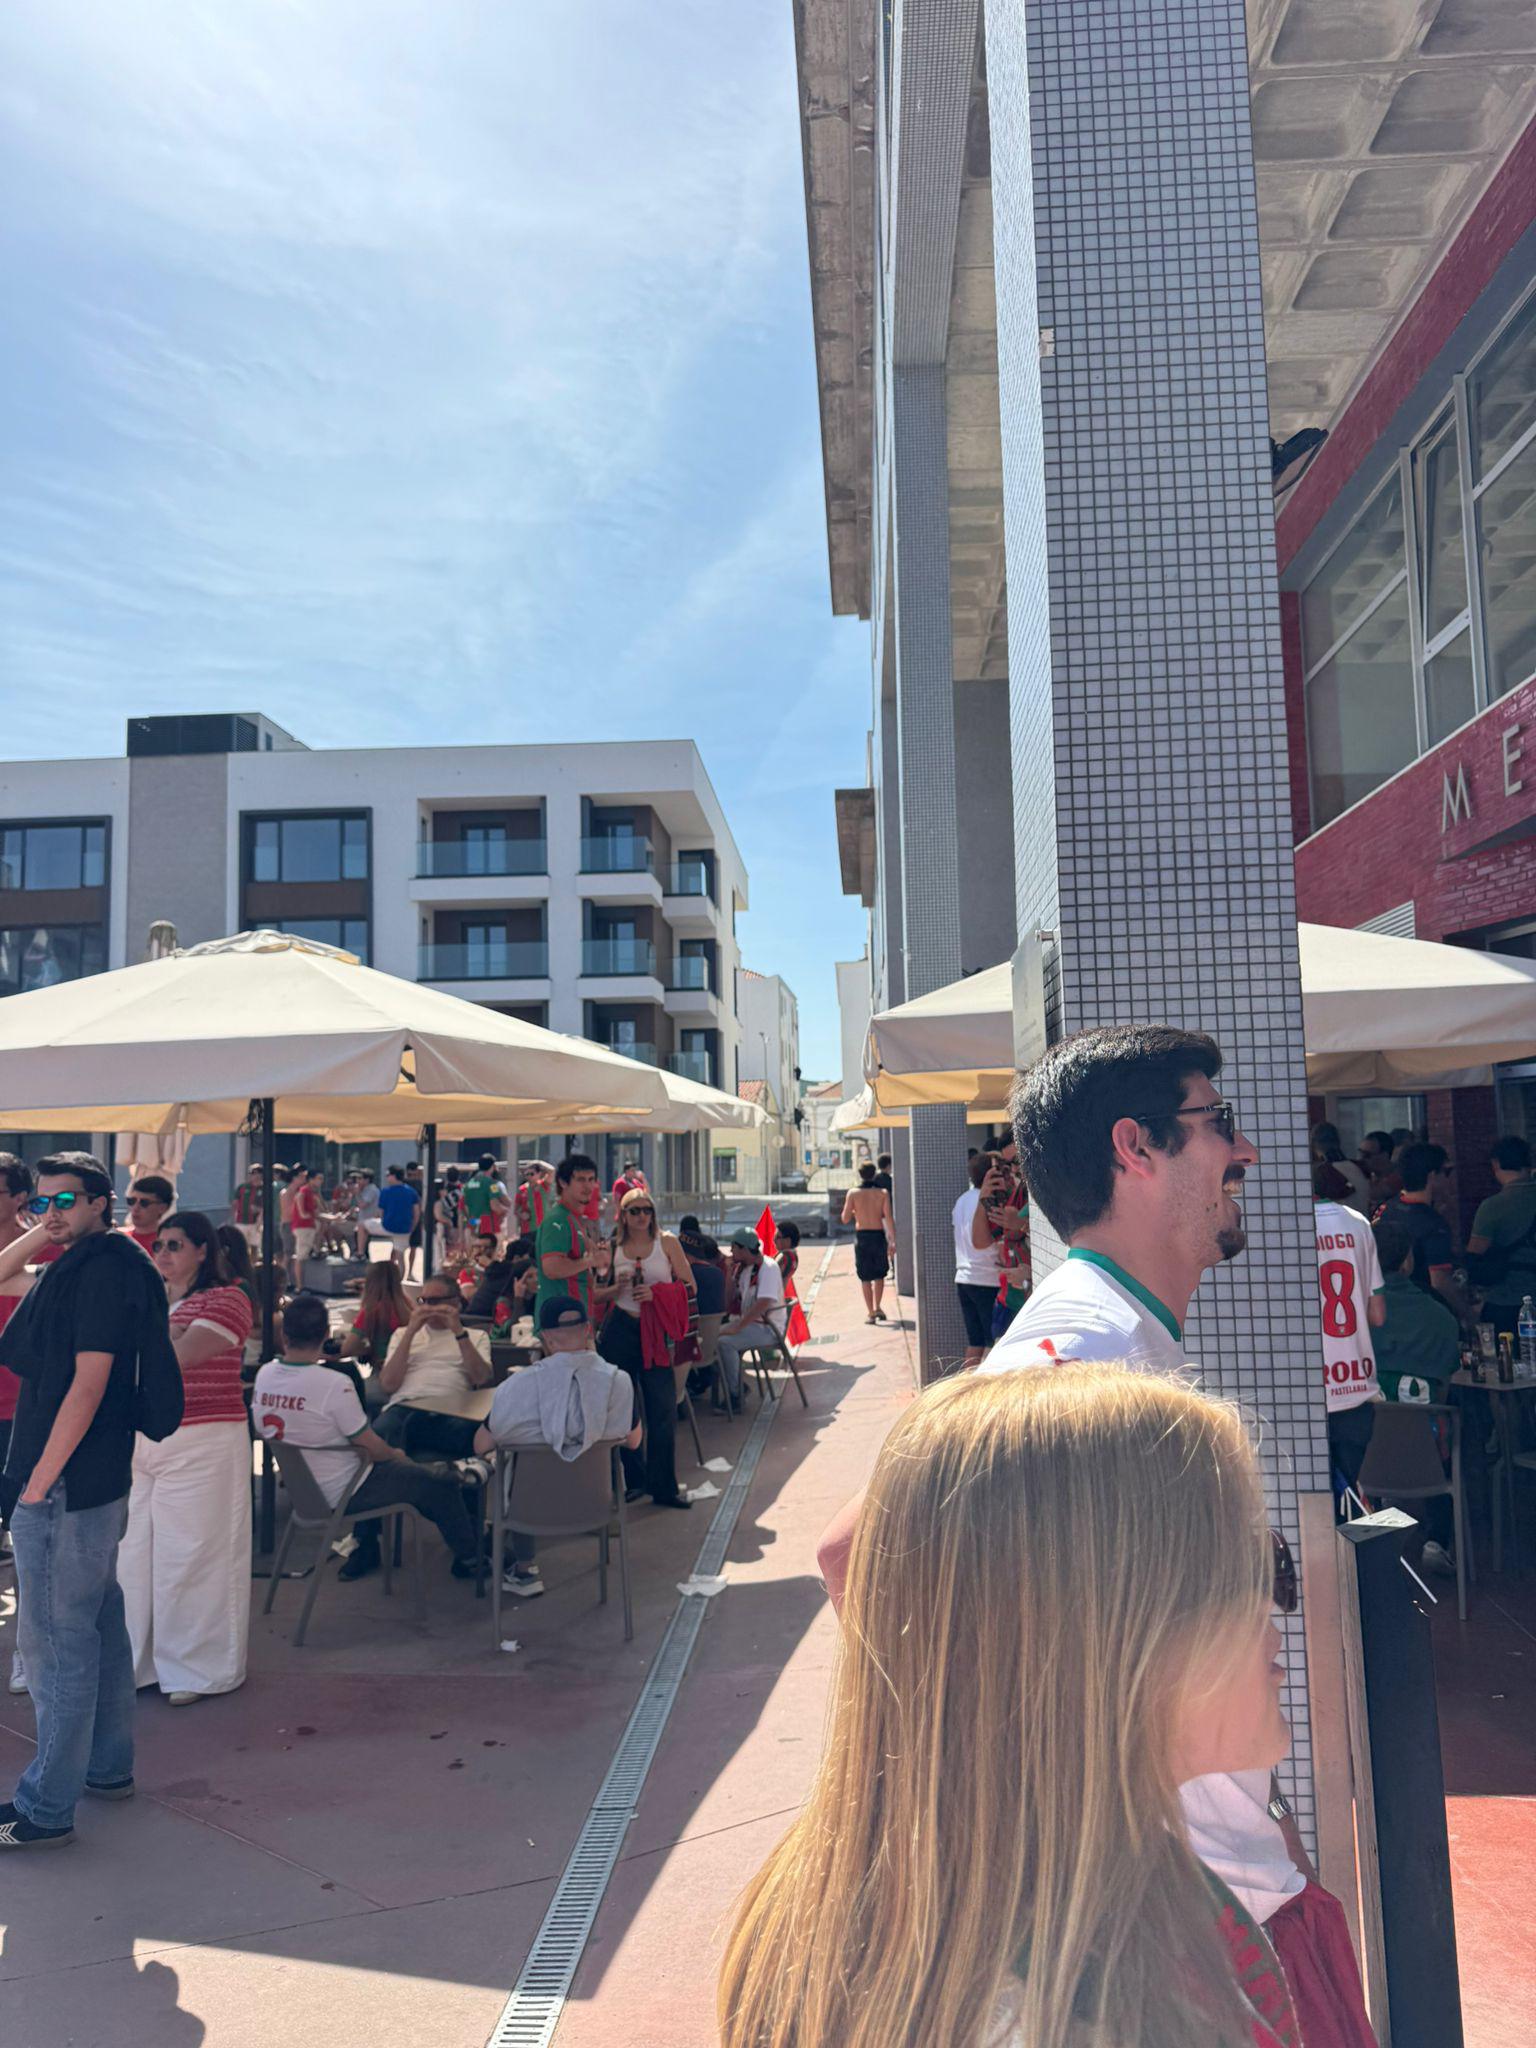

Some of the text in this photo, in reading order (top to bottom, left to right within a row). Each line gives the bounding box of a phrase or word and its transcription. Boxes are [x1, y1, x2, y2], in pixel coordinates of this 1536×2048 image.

[1441, 723, 1522, 834] ME
[1320, 1260, 1357, 1338] 8
[261, 1393, 306, 1411] BUTZKE
